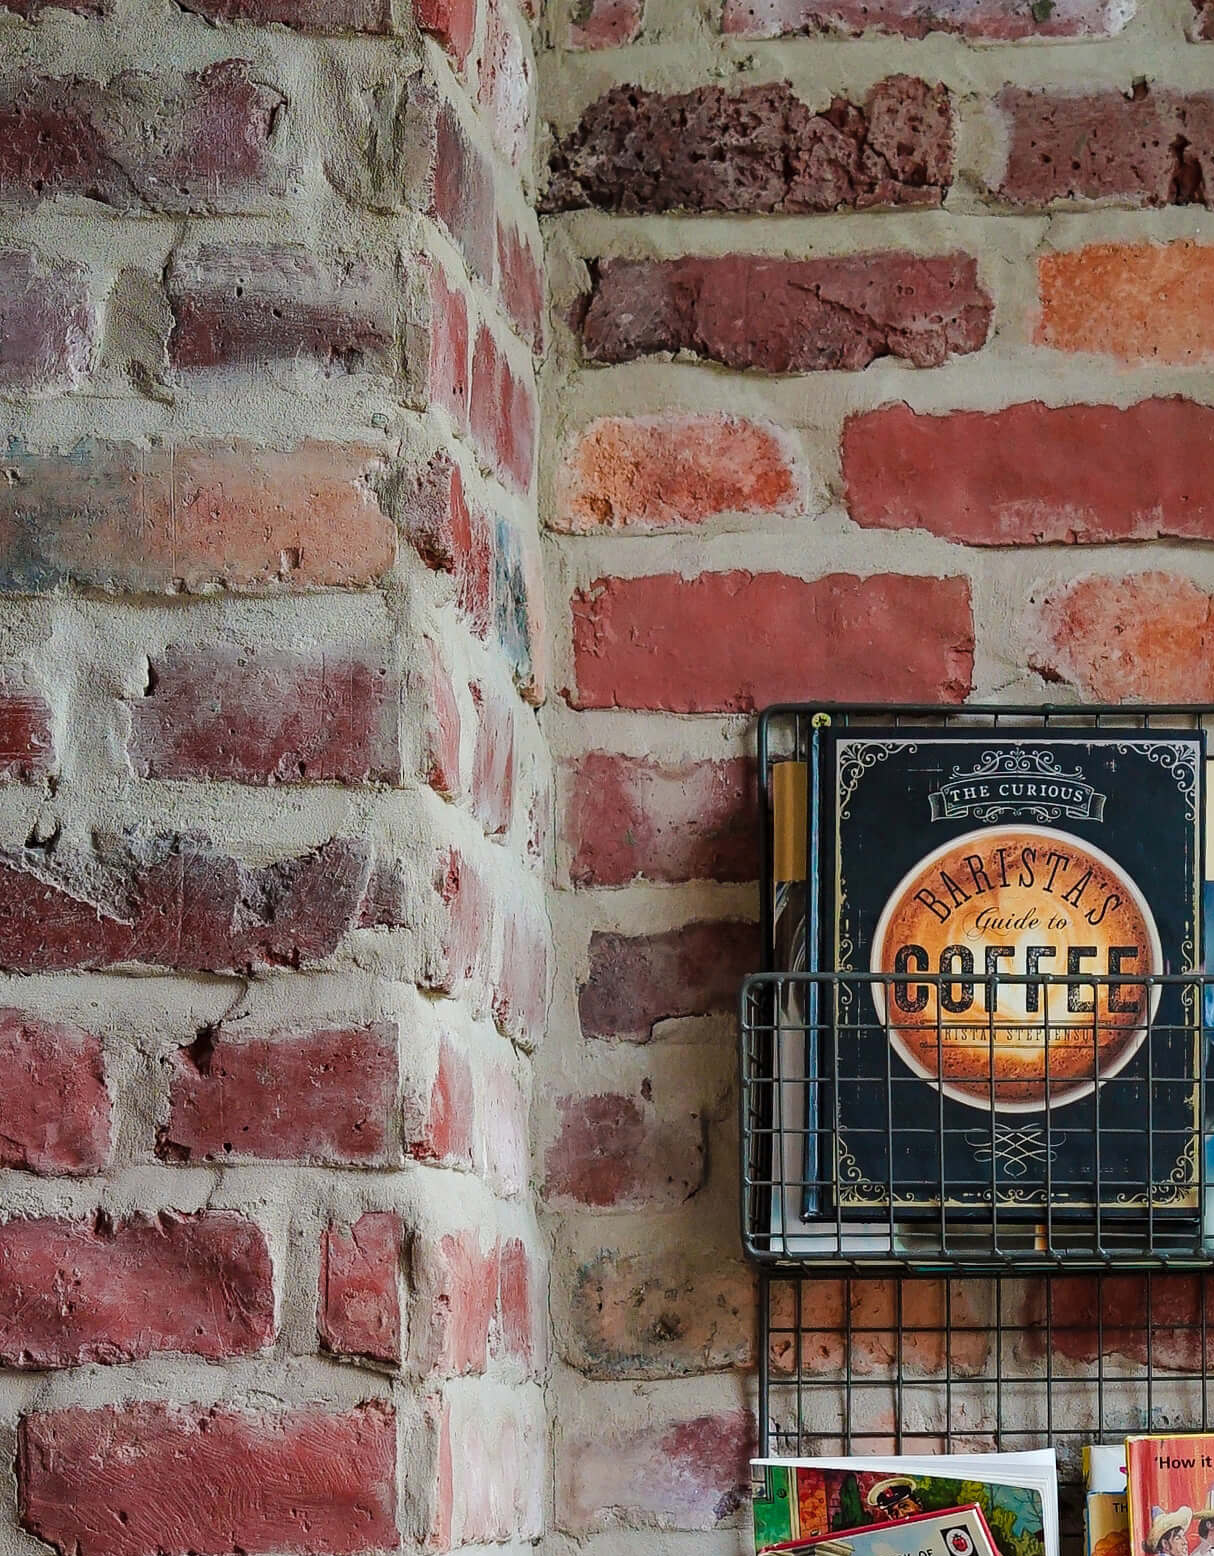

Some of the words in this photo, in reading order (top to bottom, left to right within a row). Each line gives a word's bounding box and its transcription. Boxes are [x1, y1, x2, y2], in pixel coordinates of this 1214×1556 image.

[950, 785, 990, 802] THE
[999, 783, 1084, 802] CURIOUS
[913, 847, 1123, 926] BARISTA'S
[963, 906, 1042, 939] Guide
[1048, 912, 1068, 930] to
[894, 944, 1139, 1013] COFFEE
[1154, 1456, 1196, 1470] 'How
[1201, 1454, 1212, 1467] it
